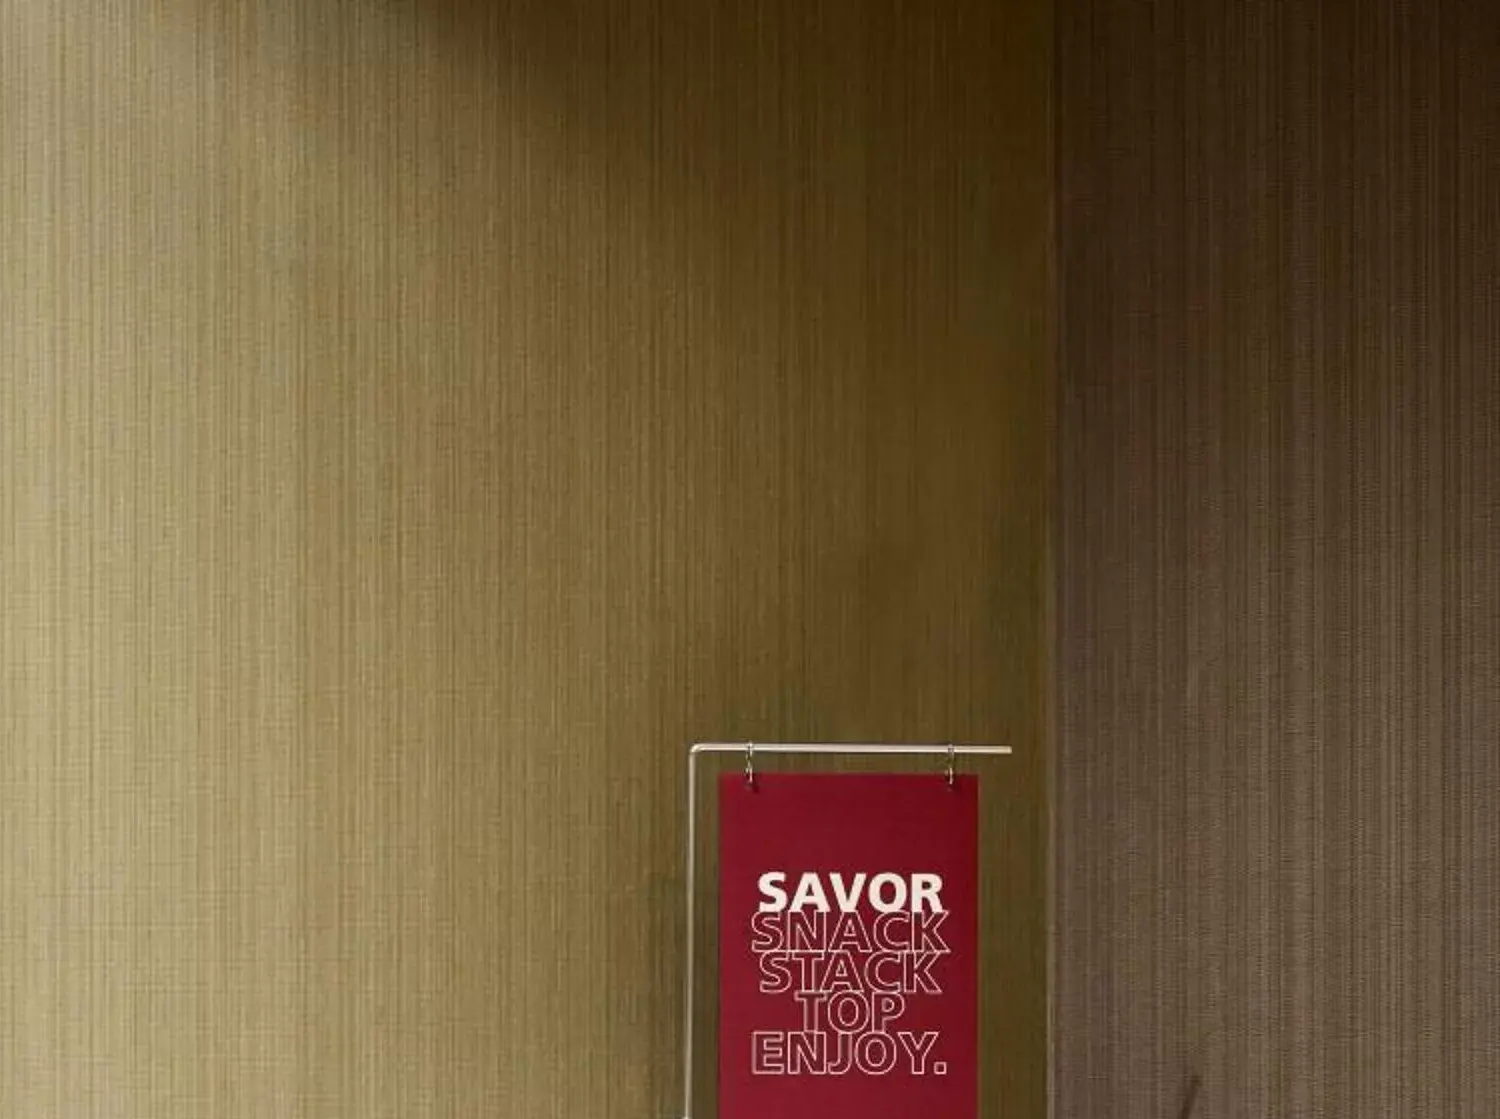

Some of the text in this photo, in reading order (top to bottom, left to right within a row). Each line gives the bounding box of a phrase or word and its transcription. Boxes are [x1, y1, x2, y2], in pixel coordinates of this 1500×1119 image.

[757, 871, 943, 912] SAVOR
[751, 910, 950, 952] SNACK
[759, 951, 942, 993] STACK
[794, 991, 905, 1034] TOP
[752, 1031, 947, 1074] ENJOY.
